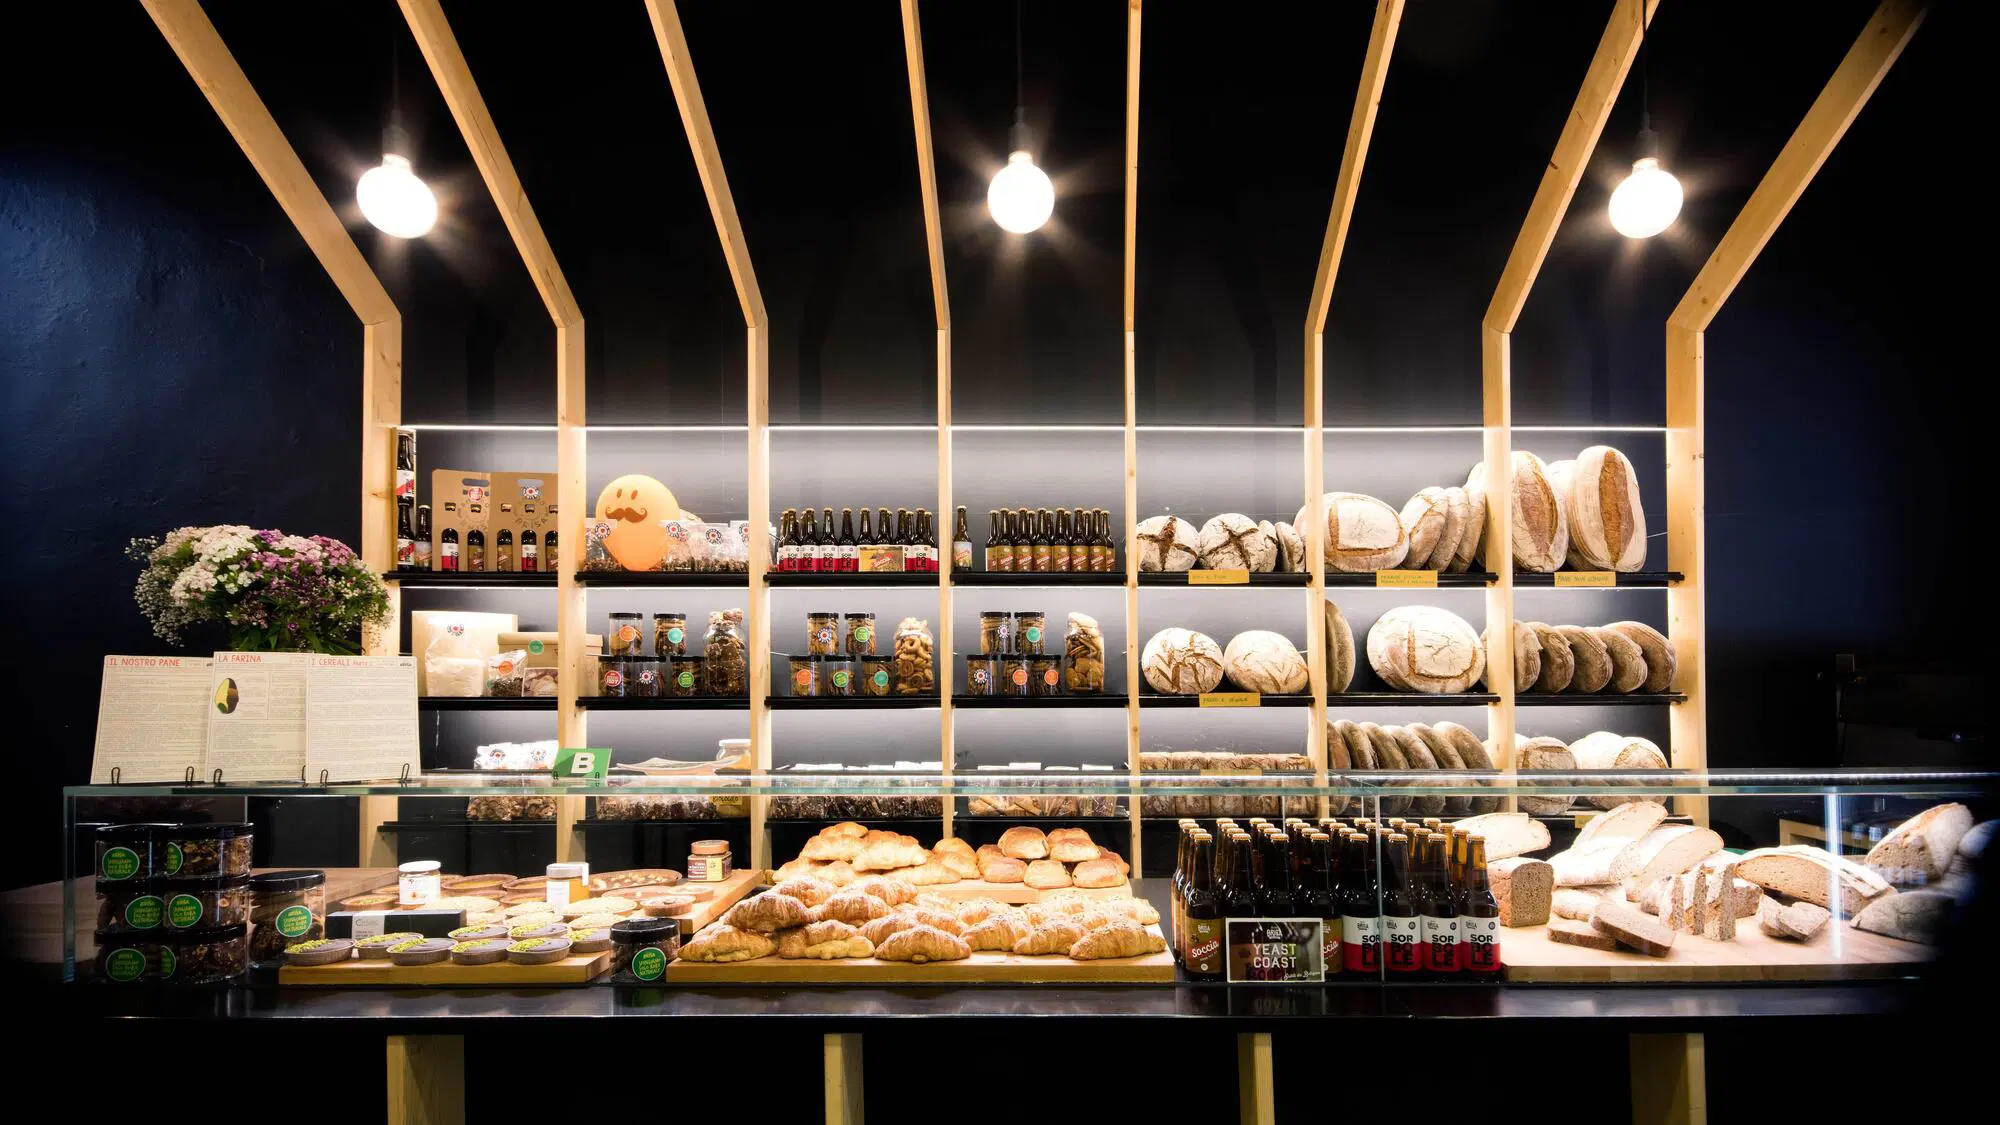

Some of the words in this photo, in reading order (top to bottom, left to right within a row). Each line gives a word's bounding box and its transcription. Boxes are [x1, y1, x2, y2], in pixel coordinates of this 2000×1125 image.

[121, 658, 156, 666] NOSTRO
[159, 658, 181, 667] PANE
[218, 654, 228, 662] LA
[231, 654, 262, 663] FARINA
[318, 658, 350, 667] CEREALI
[570, 751, 596, 774] B
[1390, 933, 1413, 943] SOR
[1431, 934, 1455, 943] SOR
[1470, 933, 1493, 943] SOR
[1191, 940, 1219, 958] Soccia
[1253, 943, 1297, 956] YEAST
[1253, 956, 1297, 969] COAST
